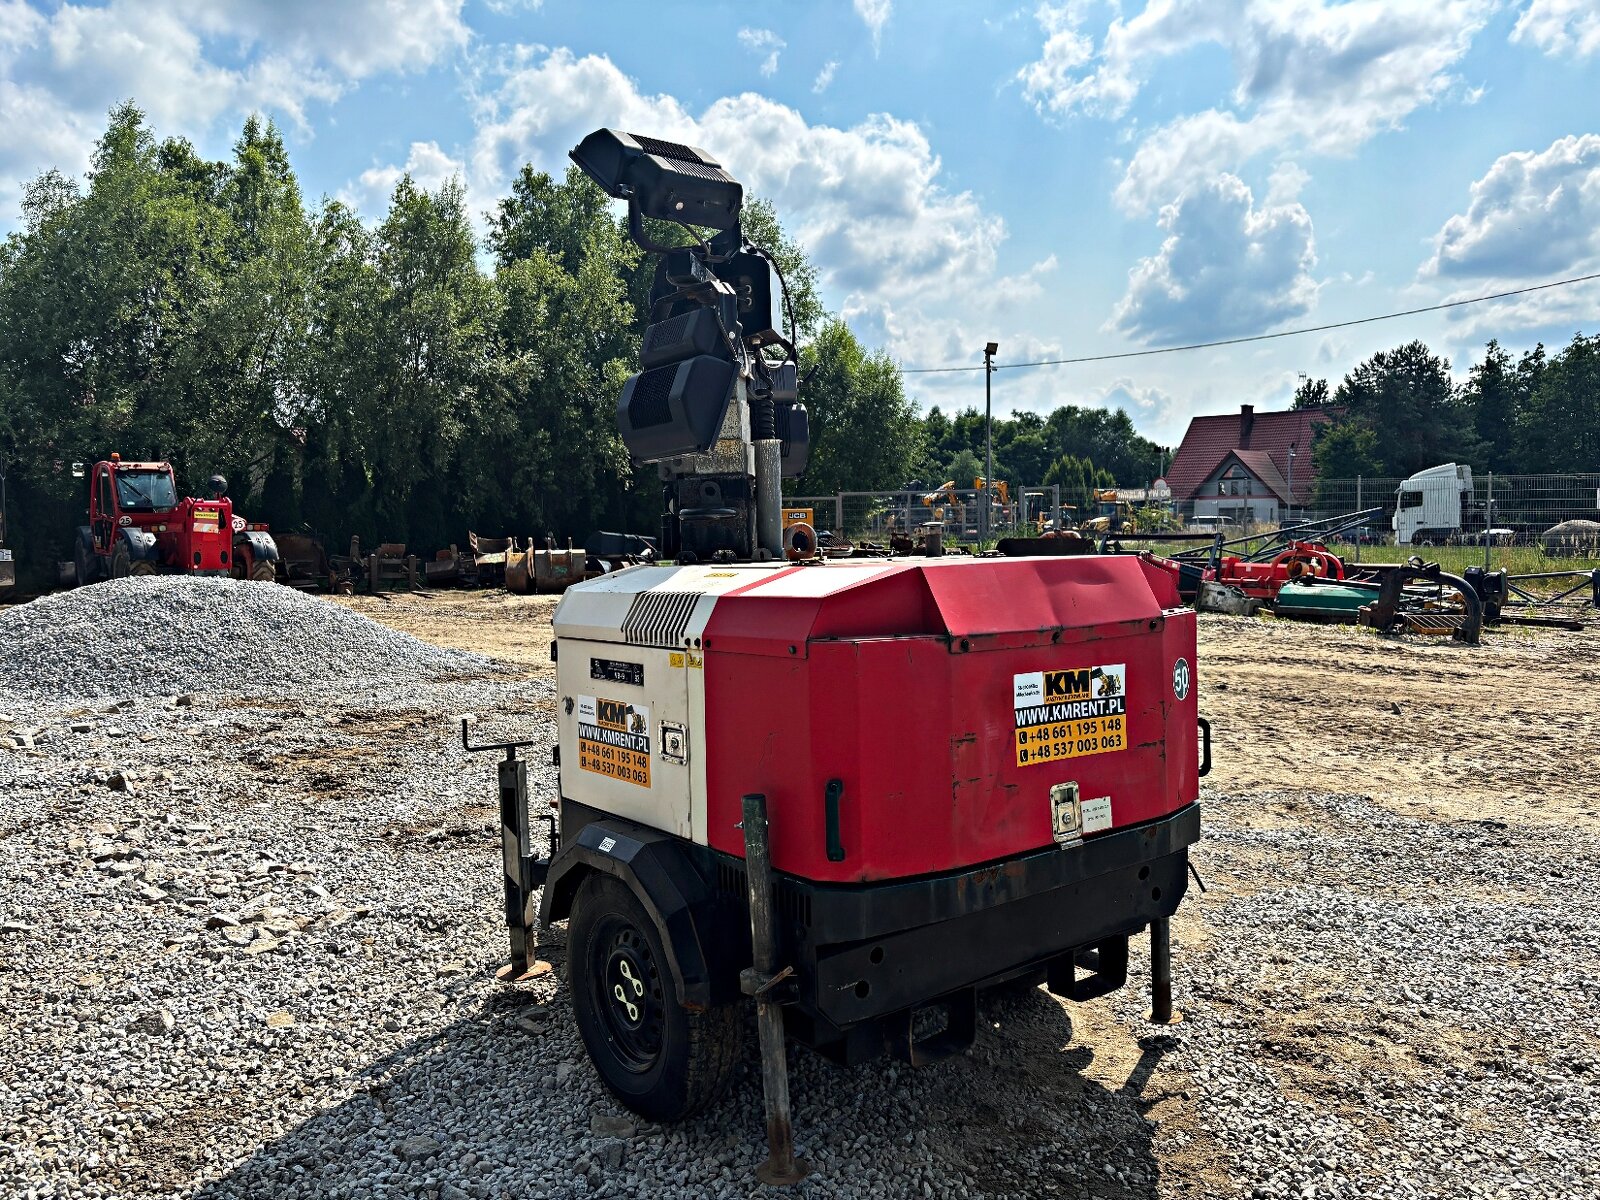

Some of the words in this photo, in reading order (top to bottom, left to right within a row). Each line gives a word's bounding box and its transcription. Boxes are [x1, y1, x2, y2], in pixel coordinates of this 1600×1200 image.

[121, 517, 131, 525] 25
[233, 520, 244, 529] 25
[1044, 670, 1090, 696] KM
[1174, 665, 1189, 692] 50
[597, 700, 626, 725] KM
[1015, 698, 1125, 727] WWW.KMRENT.PL
[579, 723, 649, 753] WWW.KMRENT.PL
[1029, 727, 1050, 743] +48
[1052, 724, 1072, 739] 661
[1076, 721, 1097, 736] 195
[1100, 717, 1122, 732] 148
[587, 744, 600, 757] +48
[601, 746, 615, 760] 661
[617, 750, 631, 764] 195
[632, 754, 647, 769] 148
[1030, 744, 1051, 760] +48
[1053, 740, 1074, 757] 537
[1076, 737, 1098, 753] 003
[1101, 734, 1122, 749] 063
[601, 761, 616, 775] 537
[617, 764, 631, 779] 003
[632, 768, 648, 784] 063
